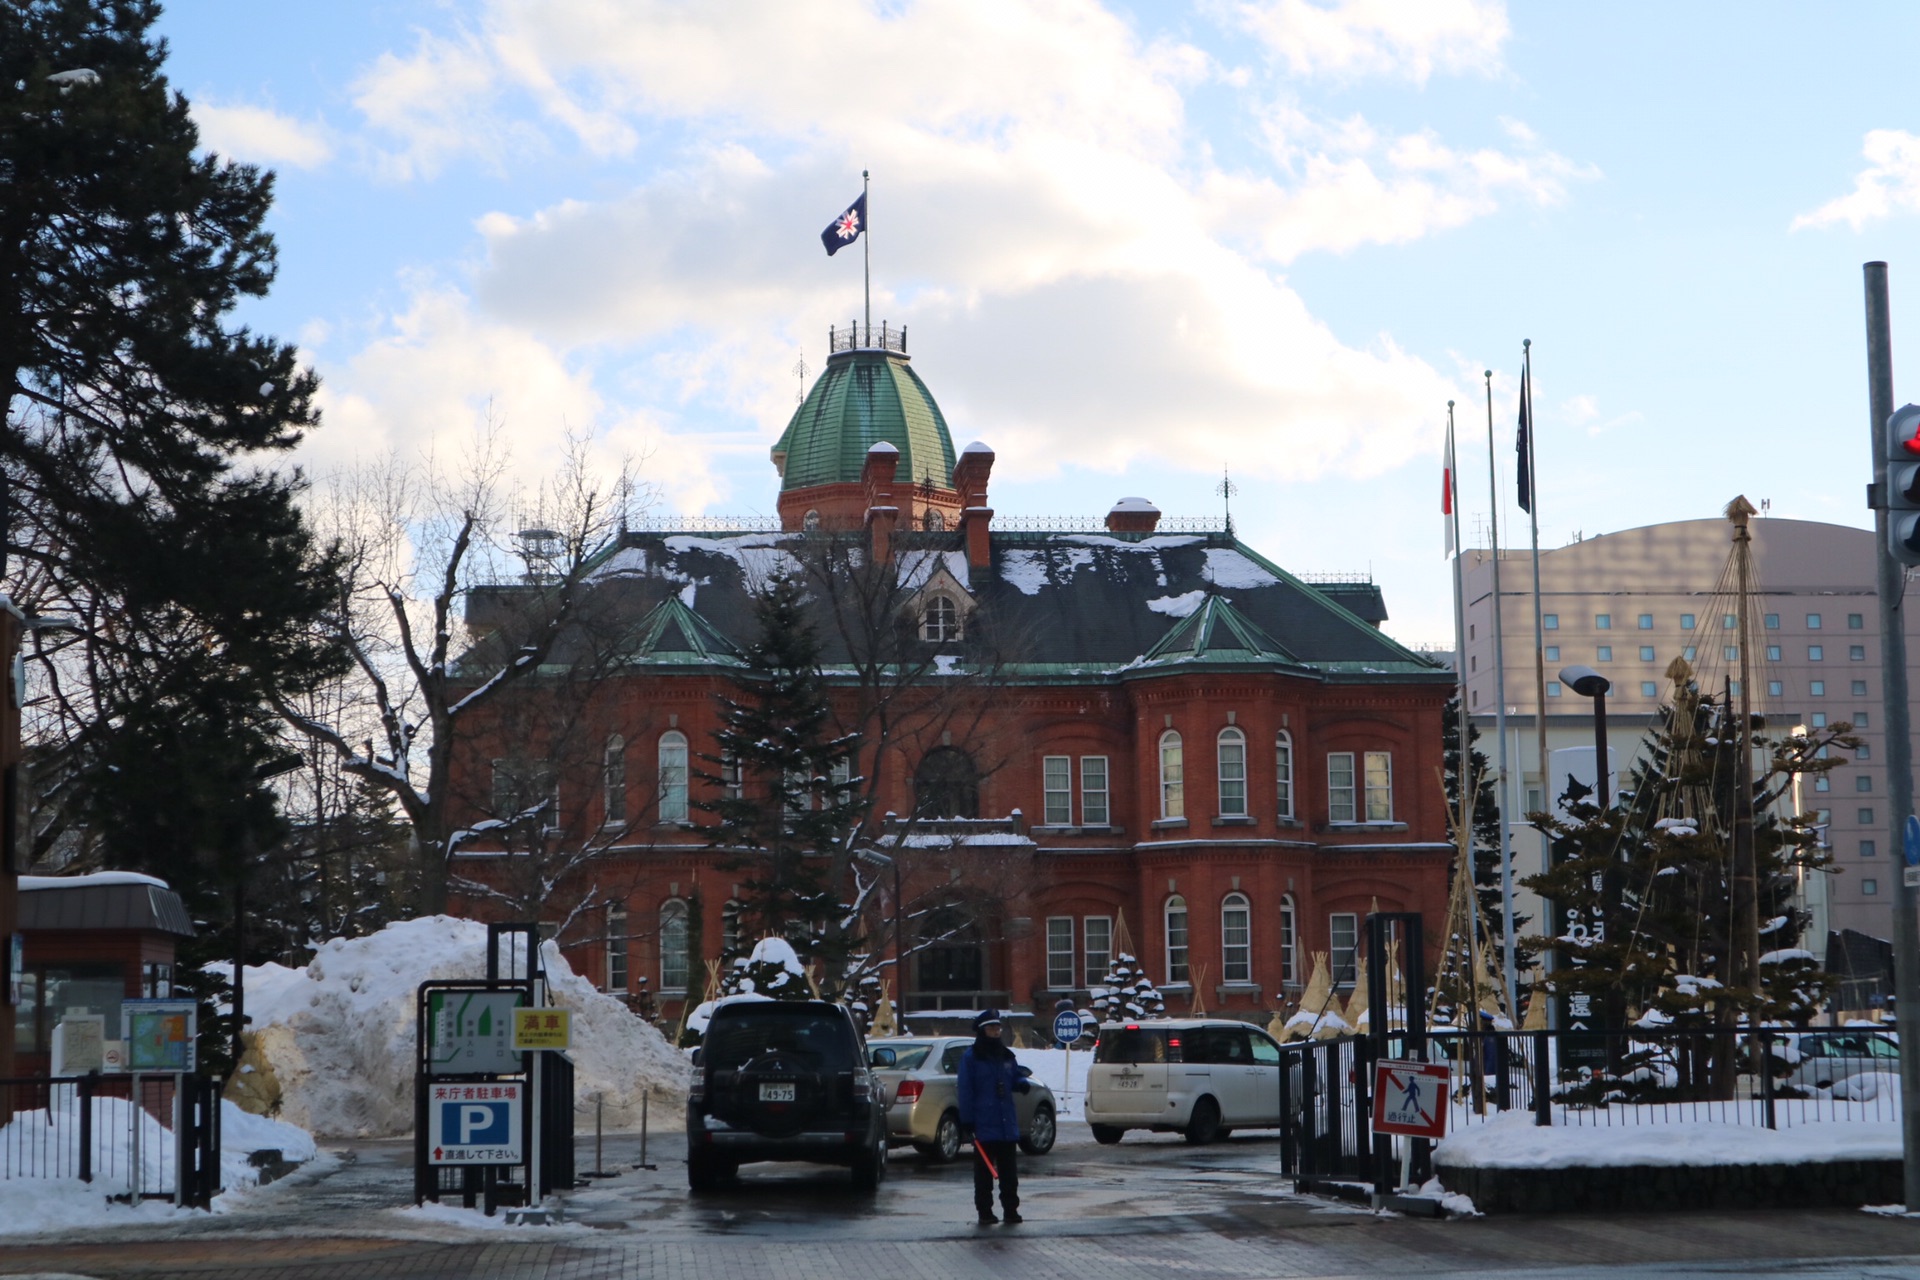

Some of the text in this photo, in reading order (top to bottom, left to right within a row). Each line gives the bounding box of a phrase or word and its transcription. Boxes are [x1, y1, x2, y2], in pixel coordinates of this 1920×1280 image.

[524, 1014, 560, 1030] 満車
[435, 1087, 517, 1100] 来庁者駐車場
[767, 1090, 793, 1100] 49-75
[1387, 1111, 1416, 1124] 通行止
[460, 1105, 494, 1144] P
[445, 1149, 518, 1160] 直進して下さい。
